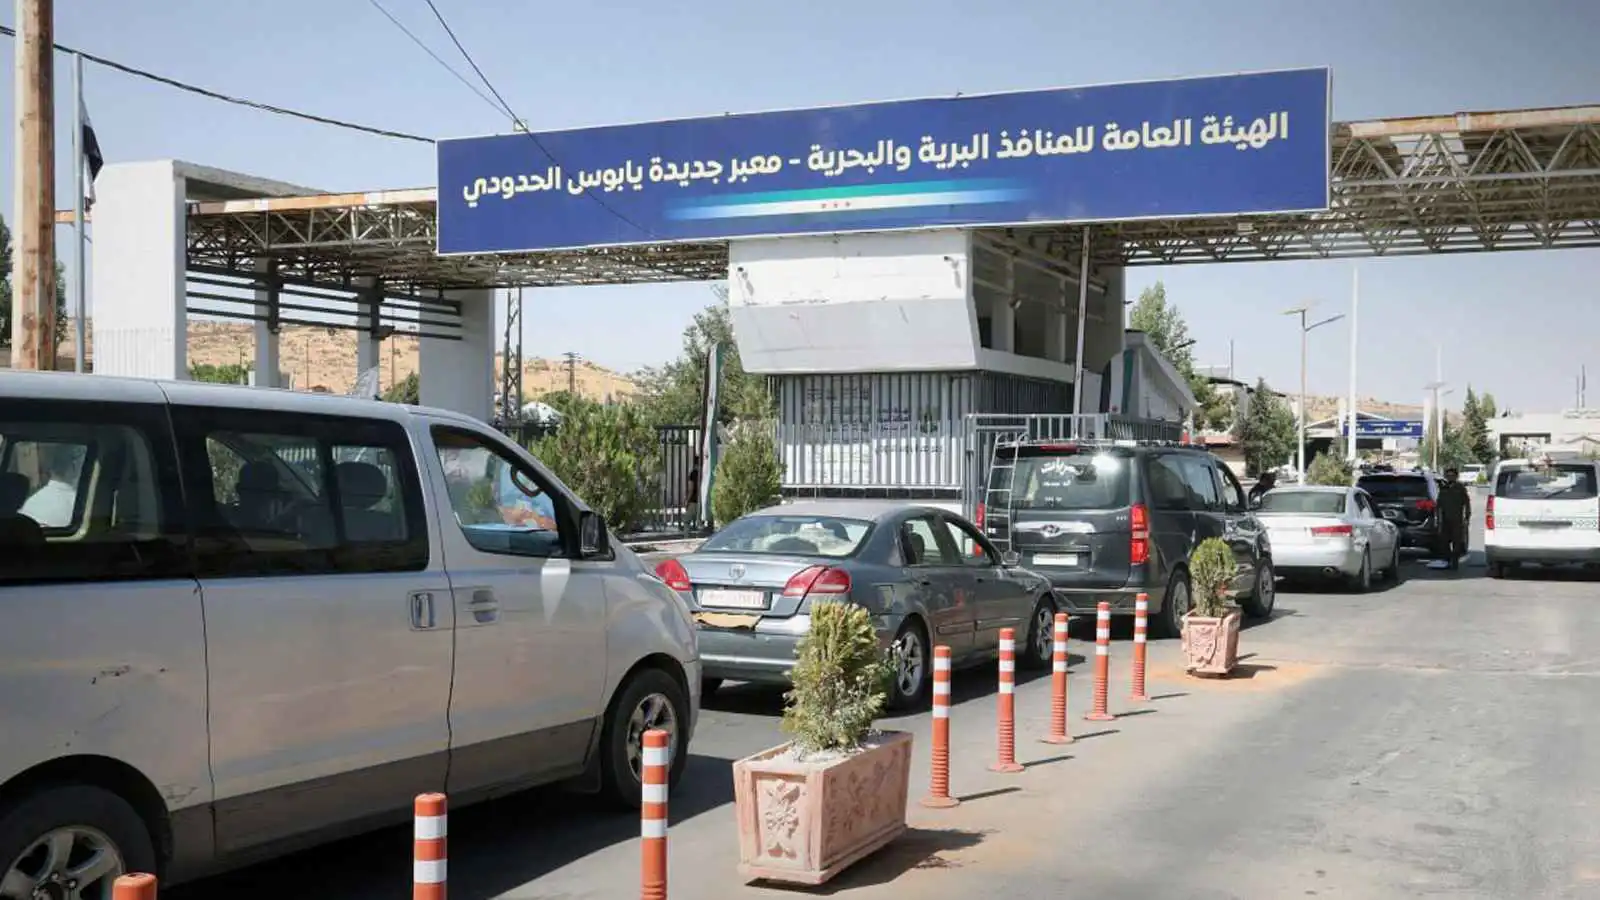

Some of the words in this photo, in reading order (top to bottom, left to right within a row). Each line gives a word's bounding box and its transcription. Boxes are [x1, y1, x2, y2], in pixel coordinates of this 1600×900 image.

[997, 126, 1094, 158] للمنافذ
[1103, 120, 1192, 152] العامة
[1201, 113, 1288, 149] الهيئة
[809, 140, 911, 172] والبحرية
[919, 134, 989, 169] البرية
[568, 160, 643, 191] يابوس
[650, 157, 723, 188] جديدة
[728, 155, 782, 184] معبر
[464, 166, 561, 208] الحدودي
